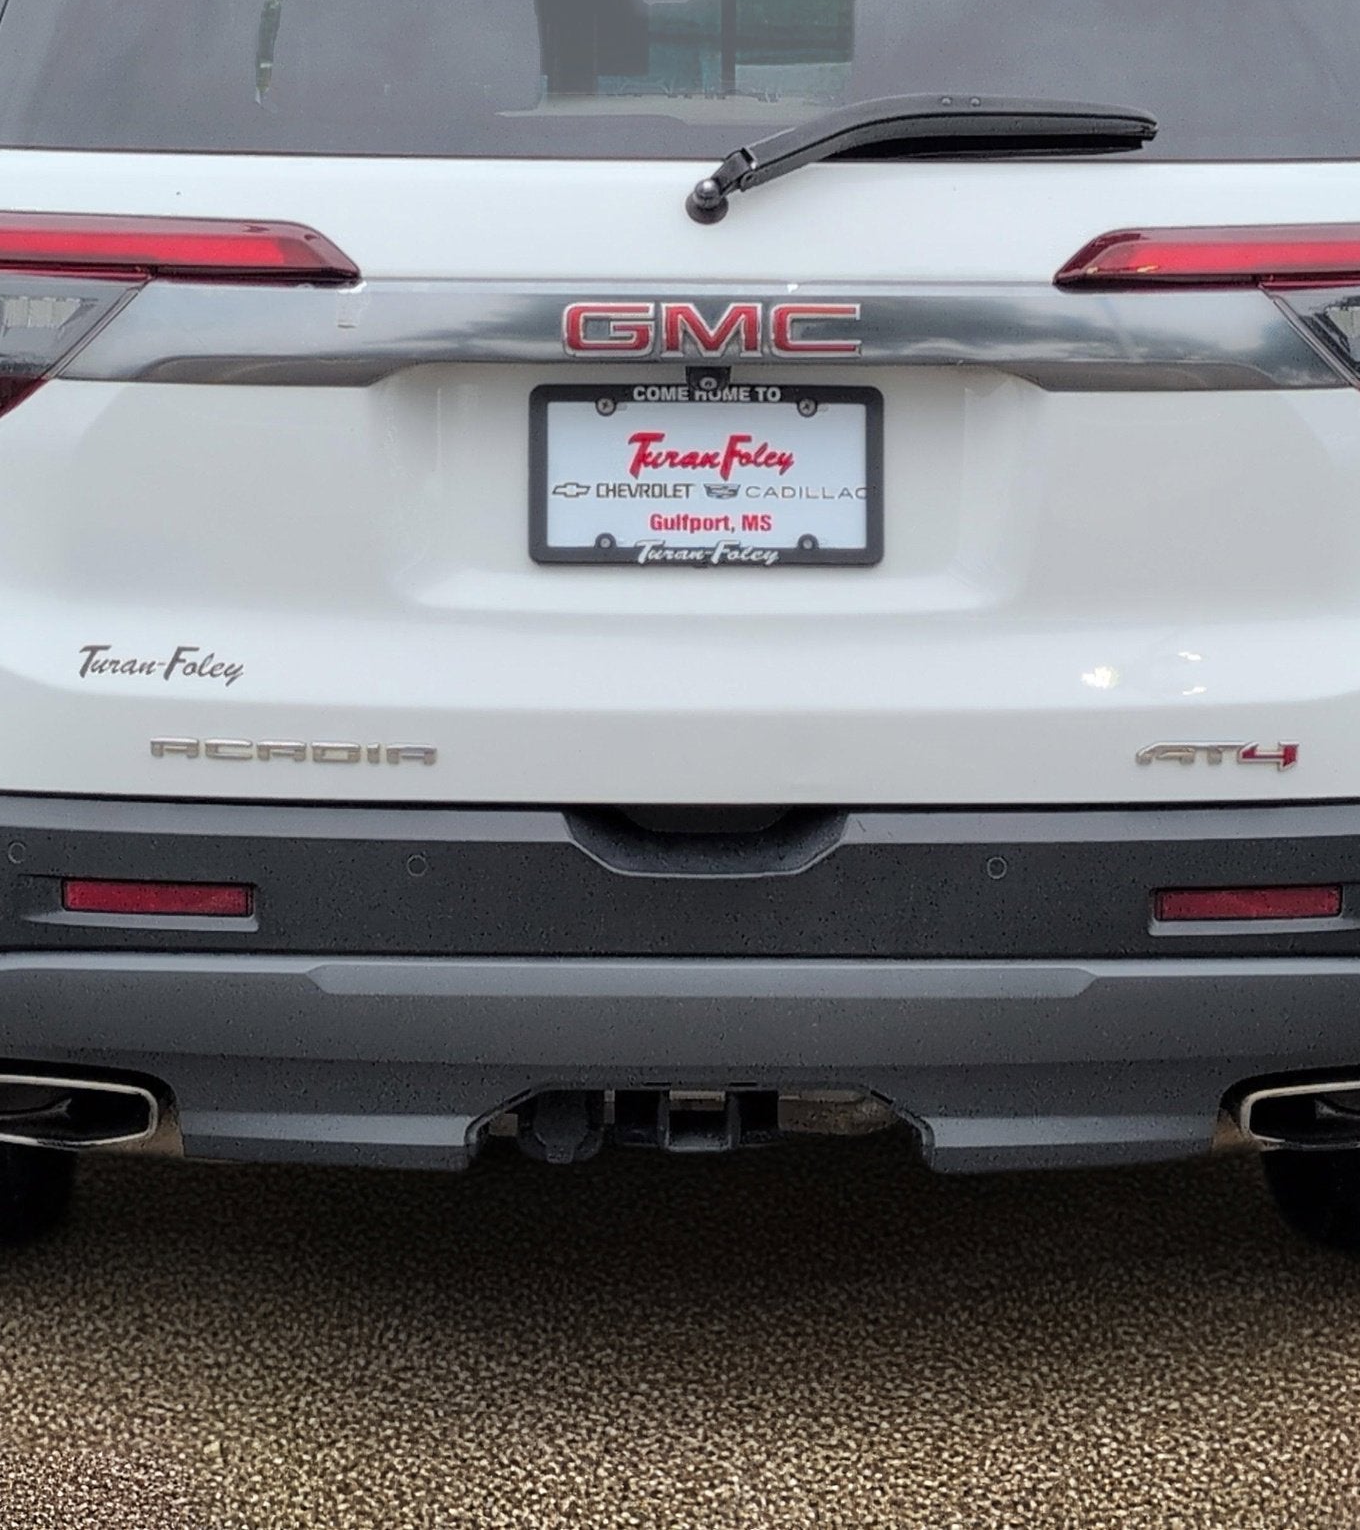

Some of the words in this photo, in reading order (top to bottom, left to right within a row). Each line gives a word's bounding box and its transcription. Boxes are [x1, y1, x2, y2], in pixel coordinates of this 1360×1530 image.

[561, 302, 862, 359] GMC
[633, 386, 690, 401] COME
[754, 386, 782, 401] TO
[627, 432, 721, 480] Turan
[719, 434, 795, 482] Foley
[596, 482, 694, 499] CHEVROLET
[745, 485, 867, 499] CADILLAC
[649, 513, 736, 534] Gulfport,
[741, 513, 773, 532] MS
[634, 539, 780, 565] Turan-Foley
[79, 644, 244, 688] Turan-Foley
[150, 736, 438, 766] ACADIA
[1136, 741, 1300, 771] AT4
